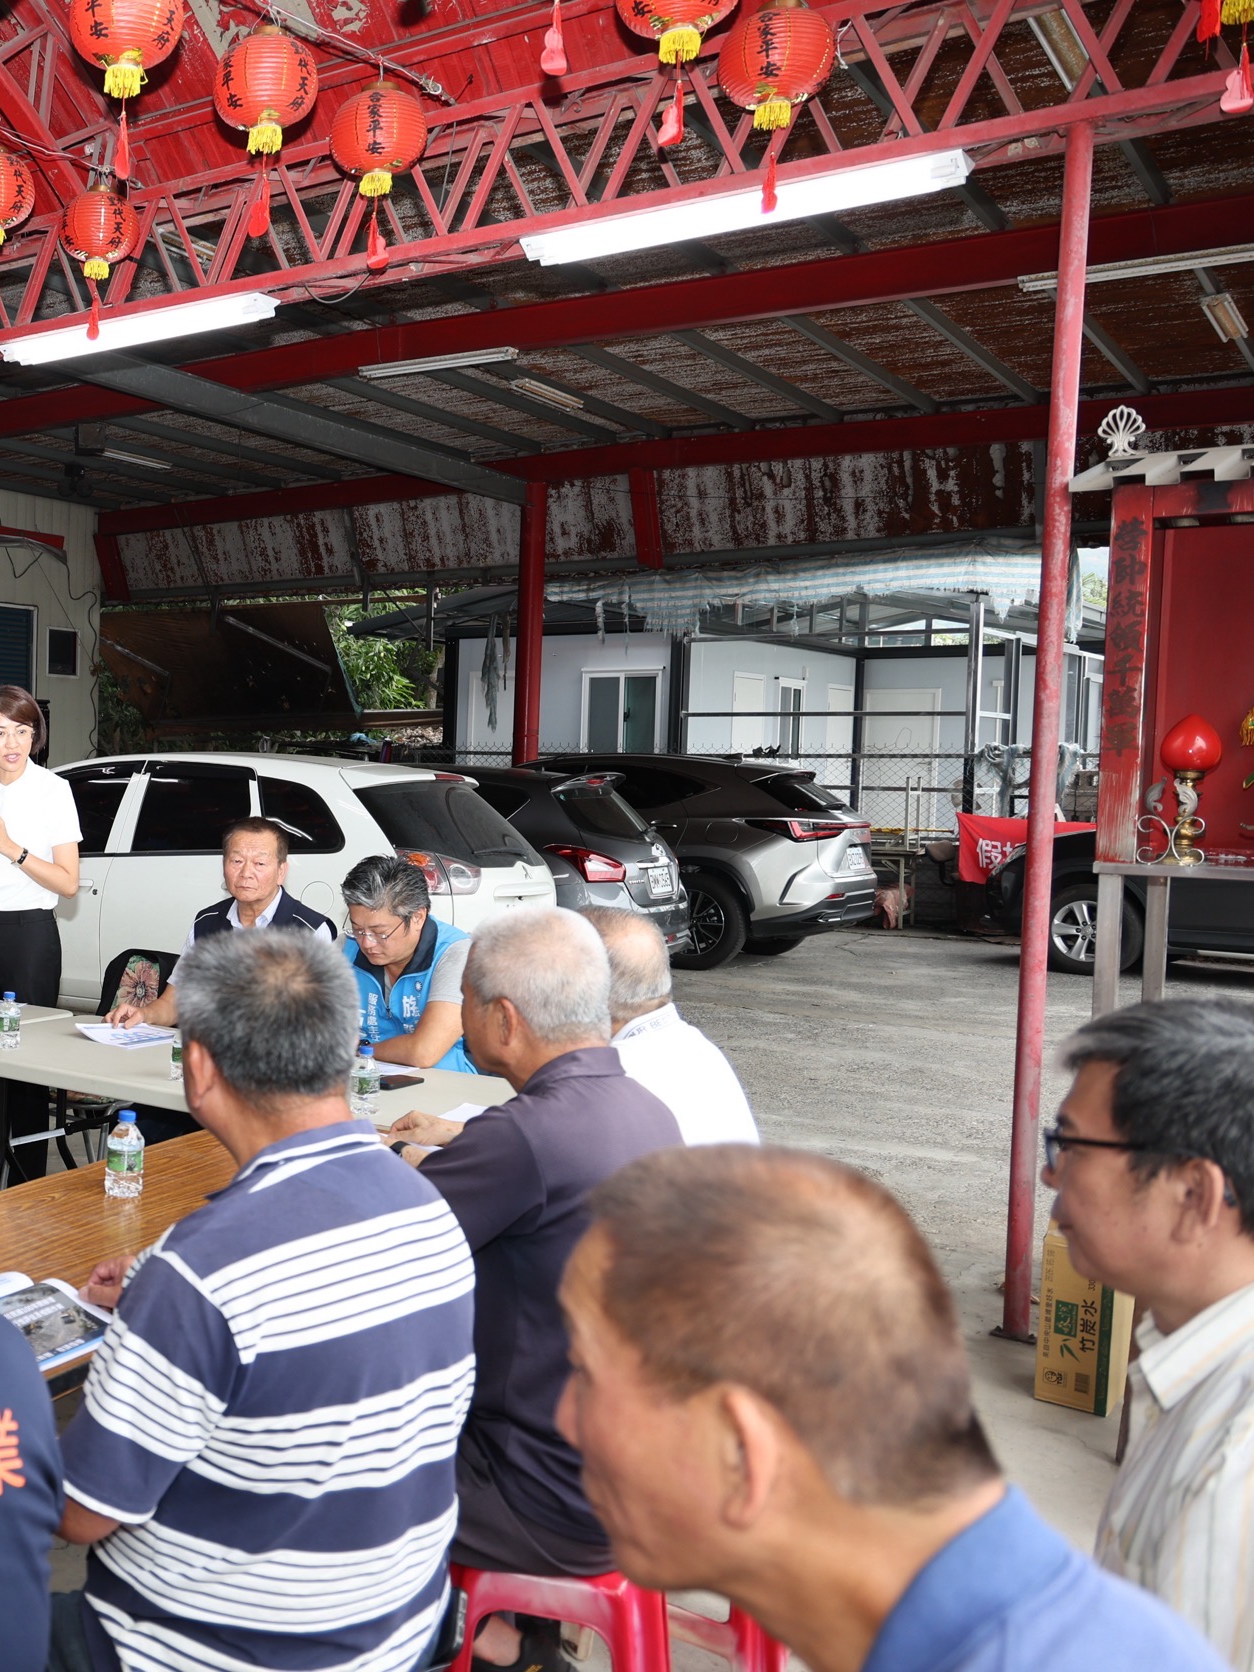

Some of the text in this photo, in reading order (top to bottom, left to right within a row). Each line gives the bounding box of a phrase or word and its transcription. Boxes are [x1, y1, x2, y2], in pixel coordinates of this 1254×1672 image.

[366, 91, 386, 155] 合家平安
[1079, 1299, 1098, 1353] 竹炭水
